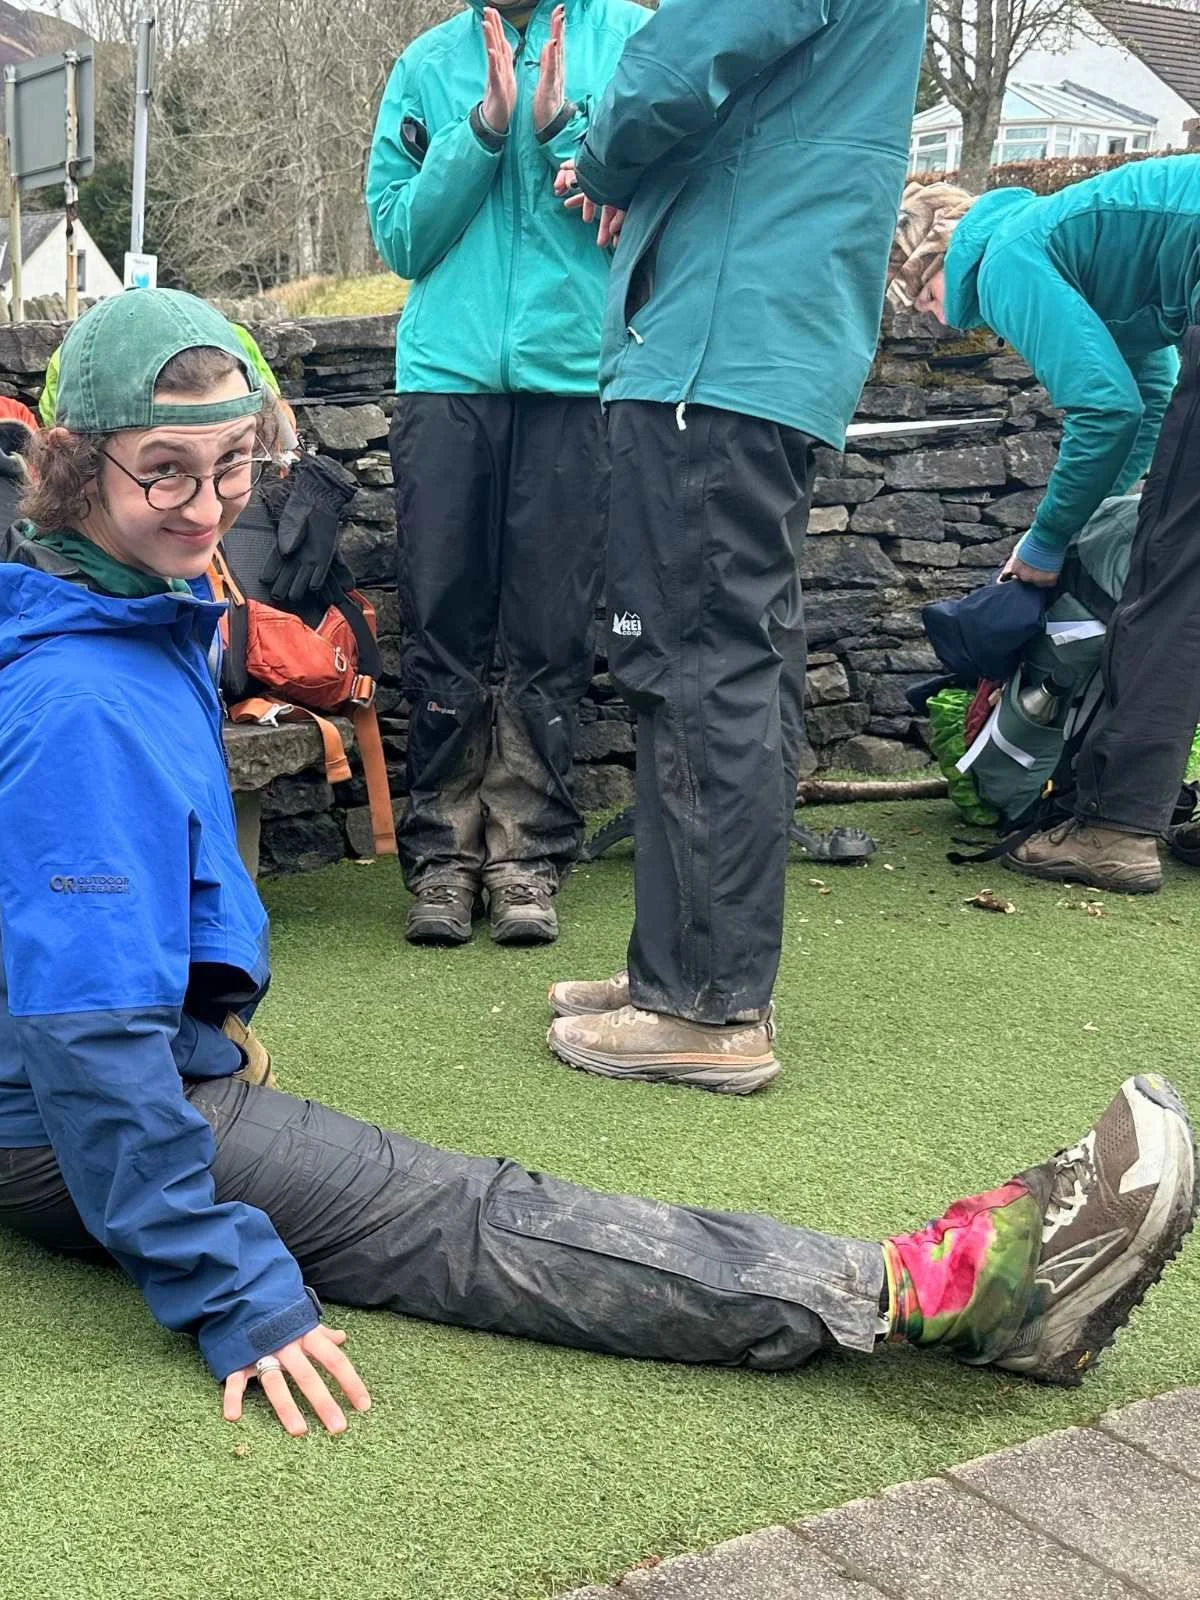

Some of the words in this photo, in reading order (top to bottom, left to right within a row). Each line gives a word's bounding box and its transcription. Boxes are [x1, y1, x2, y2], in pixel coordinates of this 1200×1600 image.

[622, 619, 641, 631] REI
[78, 876, 130, 885] OUTDOOR
[79, 885, 131, 895] RESEARCH
